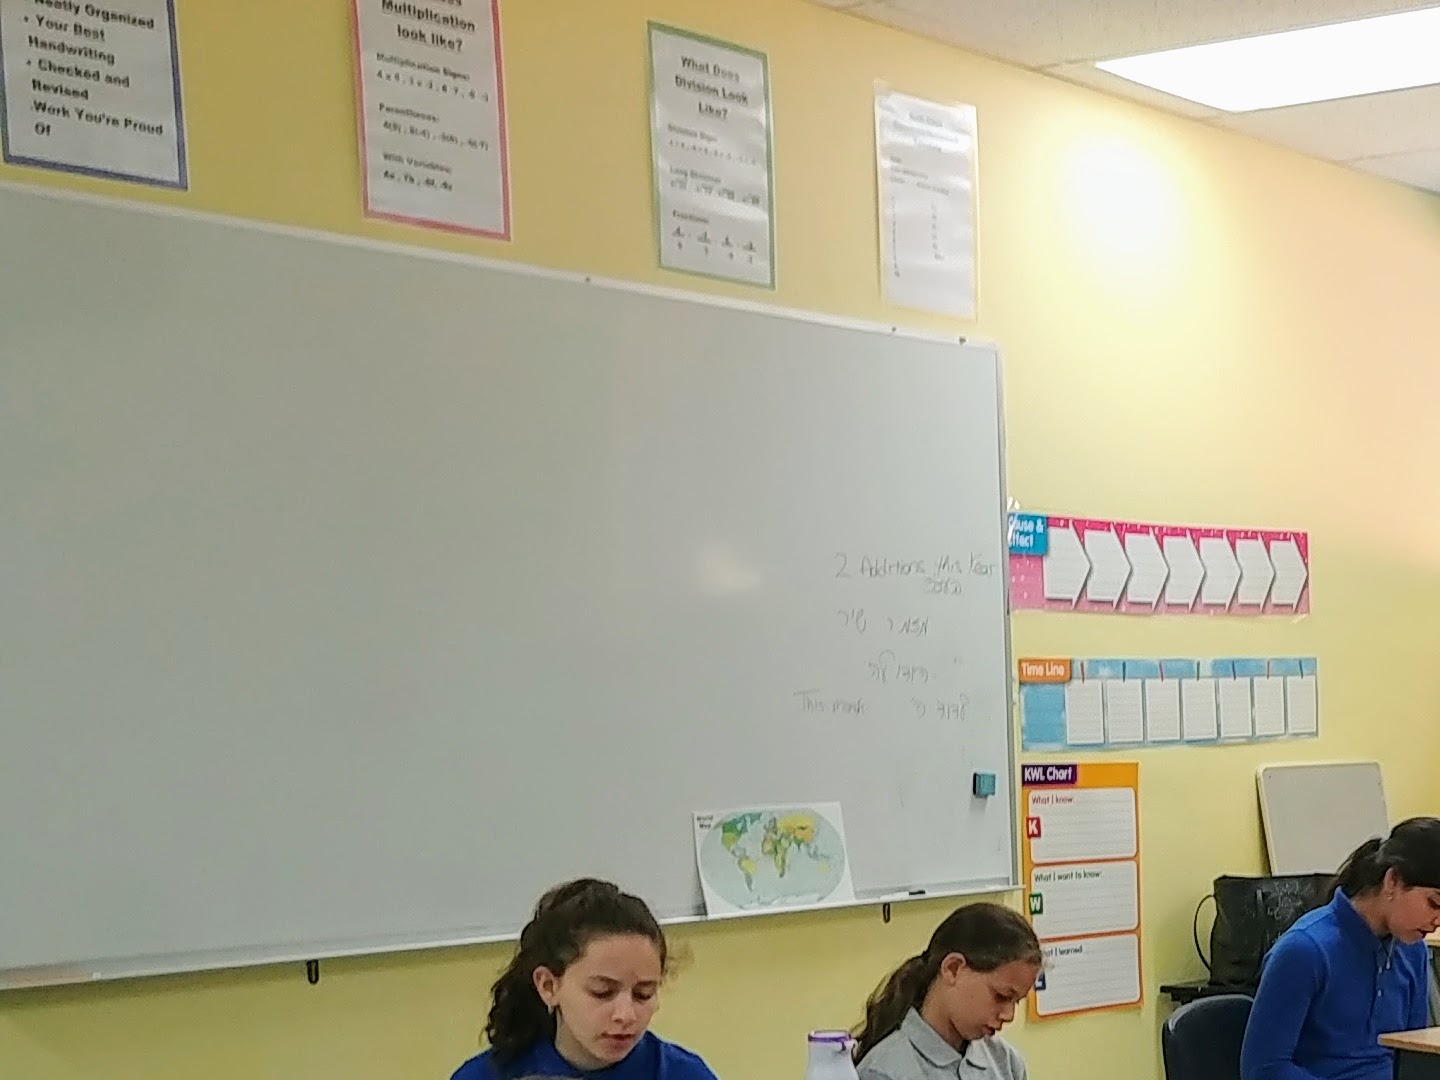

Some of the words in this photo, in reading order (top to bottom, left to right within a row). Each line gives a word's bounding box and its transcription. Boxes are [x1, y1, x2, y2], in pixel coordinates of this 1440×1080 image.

[85, 4, 155, 30] Organized
[36, 14, 69, 32] Your
[74, 22, 105, 42] Best
[397, 24, 427, 44] look
[431, 32, 463, 52] like?
[28, 35, 115, 66] Handwriting
[38, 58, 100, 82] Checked
[105, 73, 130, 88] and
[681, 55, 709, 74] What
[32, 78, 89, 100] Revised
[675, 74, 719, 97] Division
[34, 100, 70, 118] Work
[74, 106, 120, 128] You're
[124, 117, 163, 136] Proud
[698, 100, 728, 120] Like?
[34, 121, 51, 136] Of
[1021, 661, 1044, 677] Time
[1045, 661, 1065, 677] Line
[1024, 766, 1045, 782] KWL
[1046, 766, 1073, 782] Chart
[1032, 795, 1050, 805] What
[1028, 819, 1039, 836] K
[1035, 872, 1051, 882] What
[1057, 871, 1073, 881] want
[1029, 895, 1041, 912] W
